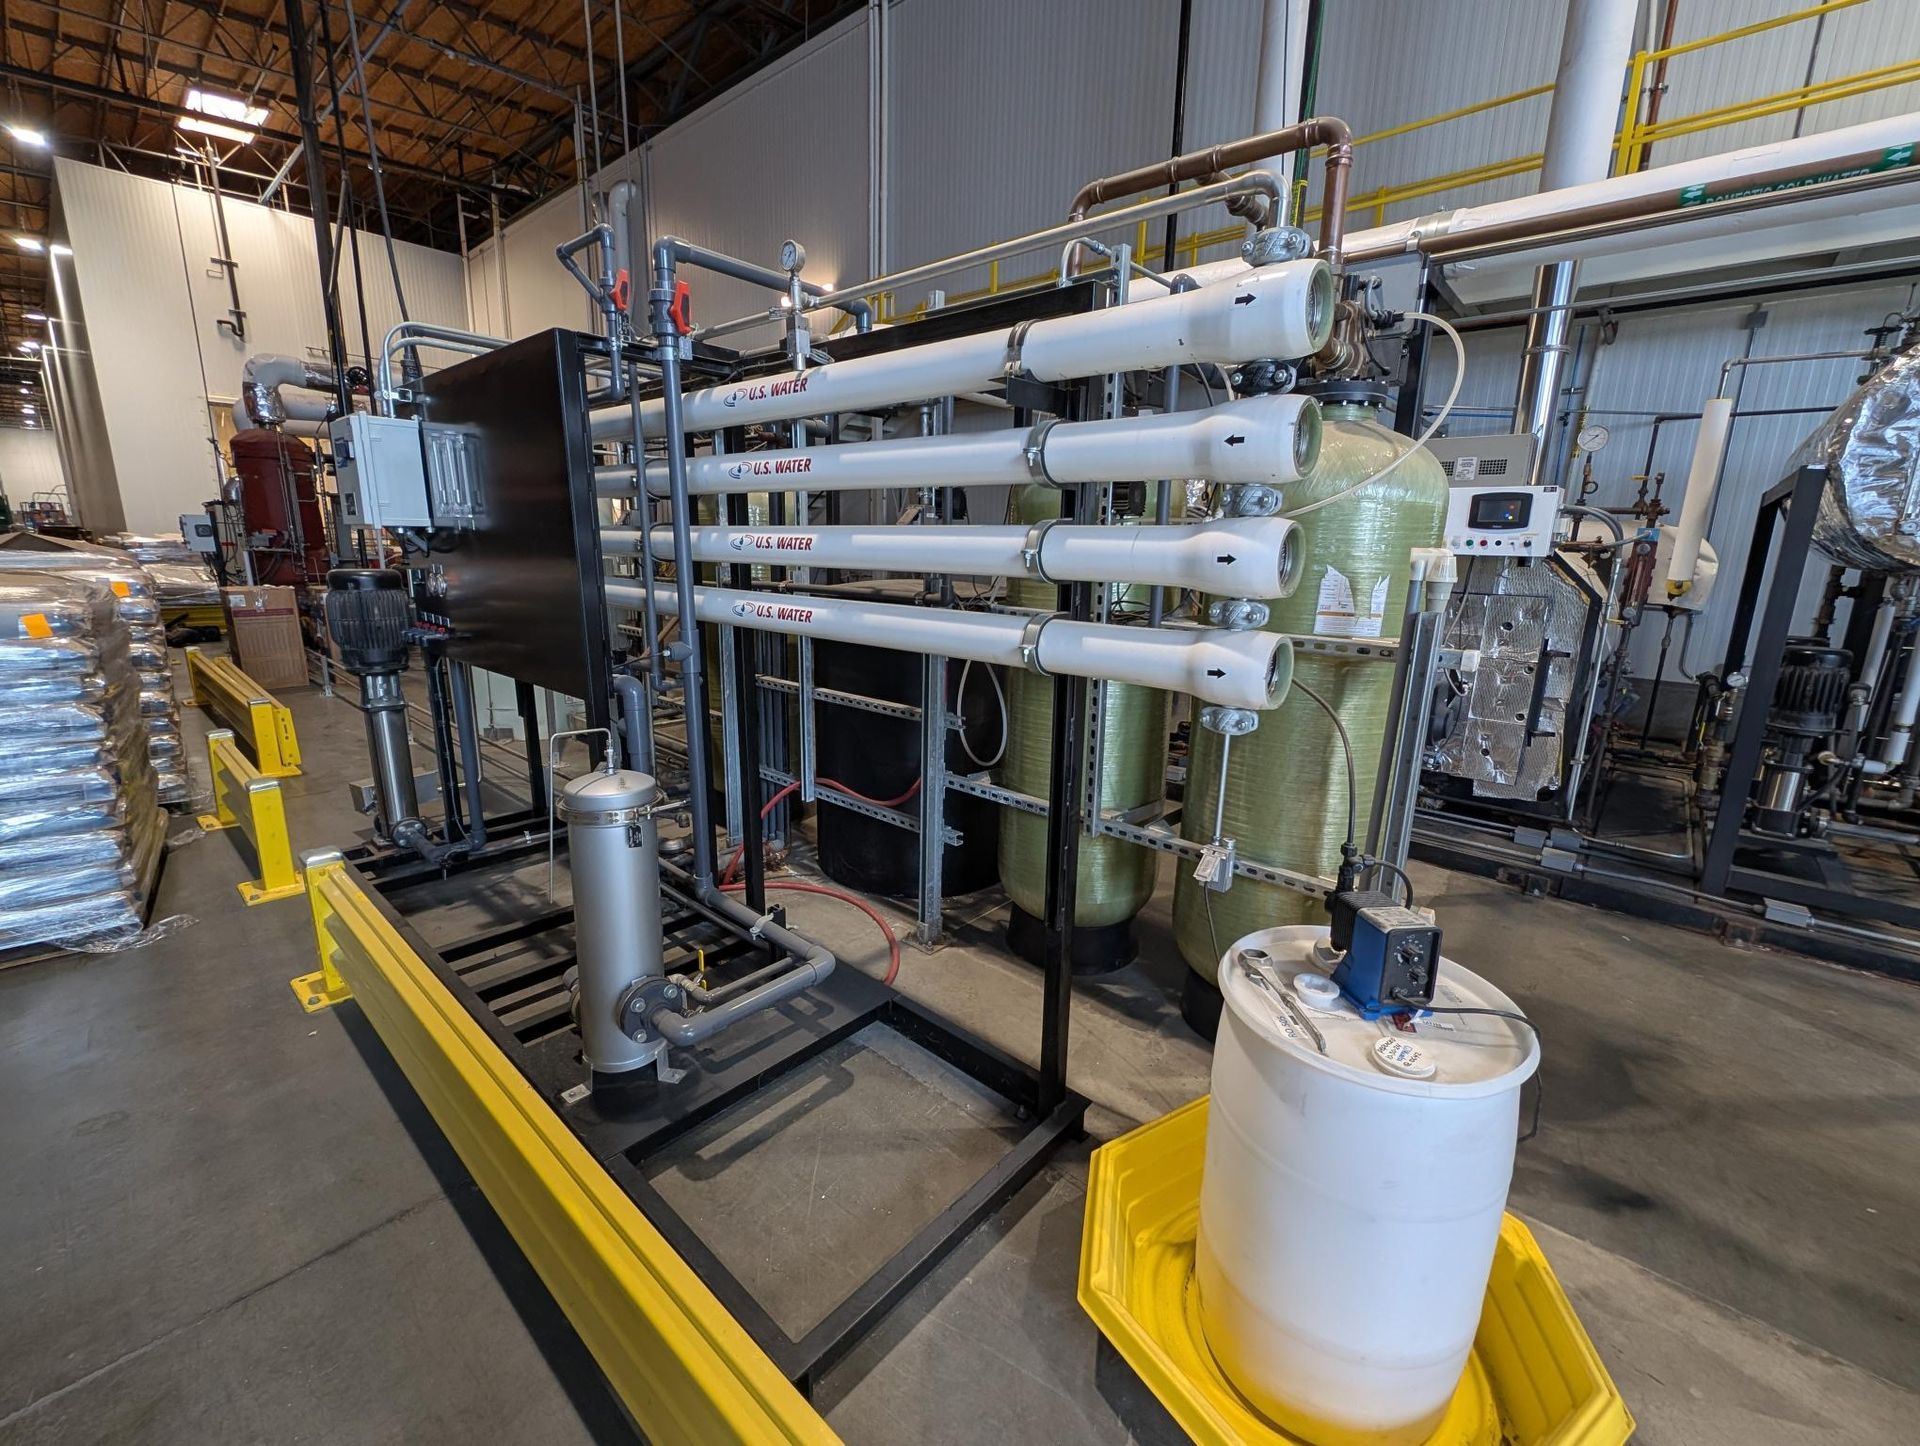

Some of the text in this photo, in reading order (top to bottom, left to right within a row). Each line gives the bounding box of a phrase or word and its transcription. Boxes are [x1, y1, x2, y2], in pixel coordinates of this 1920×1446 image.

[749, 378, 808, 400] U.S. WATER
[753, 458, 812, 475] U.S. WATER
[755, 537, 813, 550] U.S. WATER
[756, 605, 813, 623] U.S. WATER
